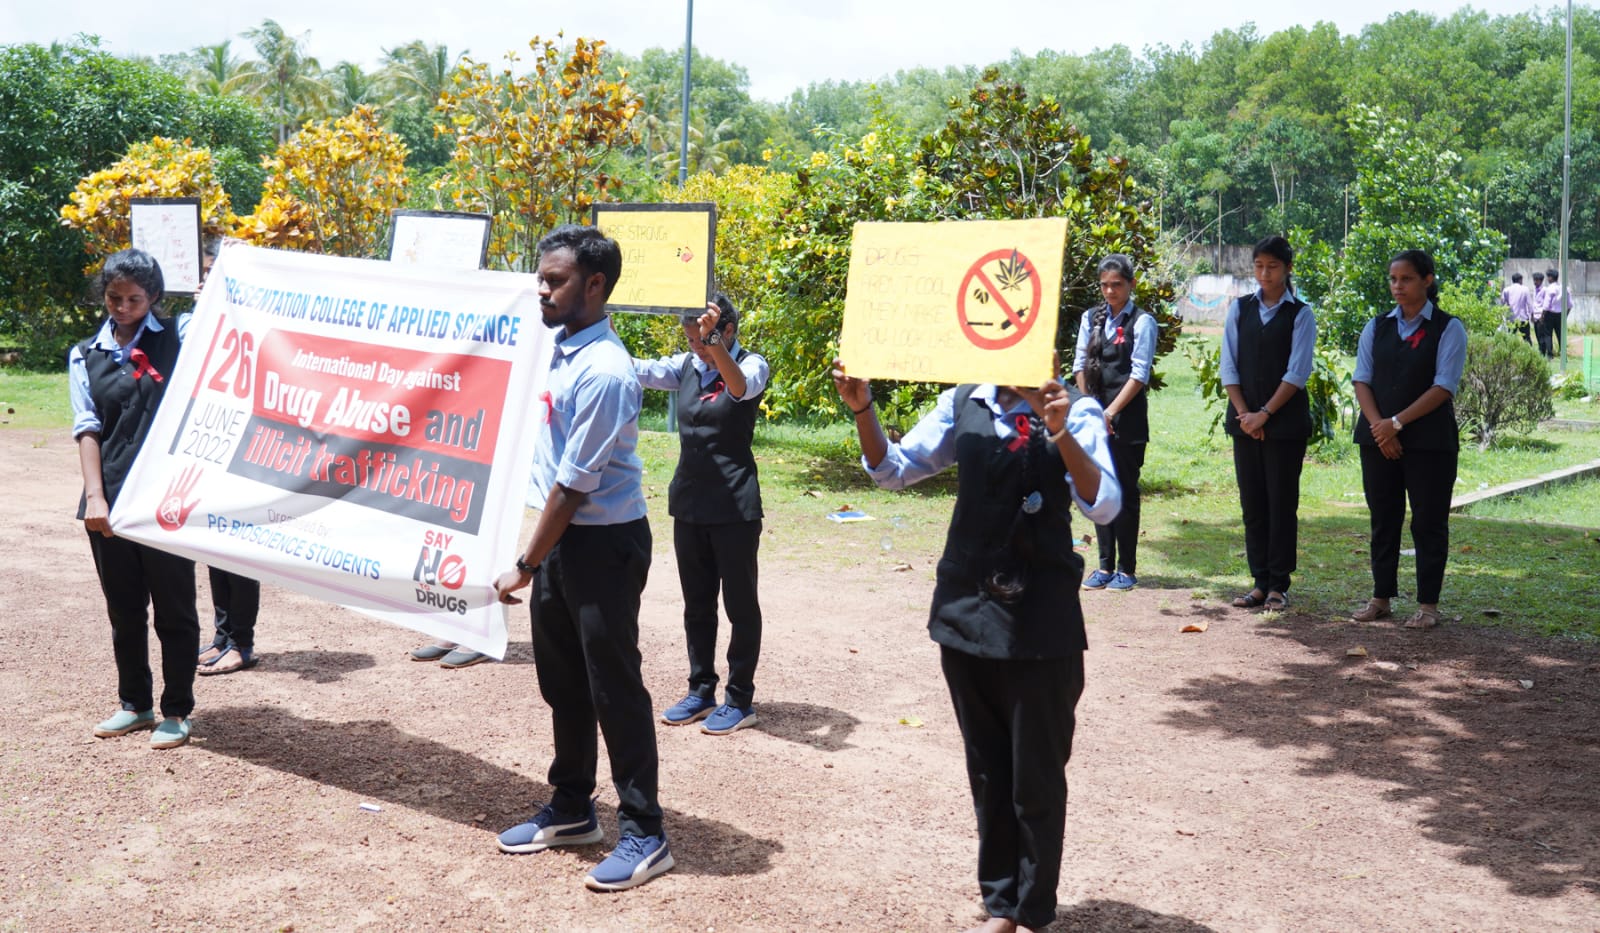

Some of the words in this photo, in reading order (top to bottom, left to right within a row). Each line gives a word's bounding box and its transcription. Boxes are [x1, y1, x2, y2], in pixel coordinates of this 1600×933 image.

[309, 295, 367, 328] COLLEGE
[367, 301, 388, 331] OF
[387, 305, 451, 340] APPLIED
[452, 312, 521, 347] SCIENCE
[207, 327, 255, 399] 26
[291, 348, 377, 381] International
[377, 362, 405, 387] Day
[403, 367, 462, 392] against
[194, 402, 246, 437] JUNE
[263, 370, 323, 428] Drug
[323, 386, 412, 438] Abuse
[424, 408, 486, 452] and
[183, 429, 232, 465] 2022
[243, 425, 313, 477] illicit
[308, 441, 476, 524] trafficking
[207, 513, 228, 533] PG
[229, 519, 307, 557] BIOSCIENCE
[305, 542, 382, 581] STUDENTS
[423, 529, 454, 551] SAY
[413, 545, 467, 591] NO
[415, 587, 468, 616] DRUGS
